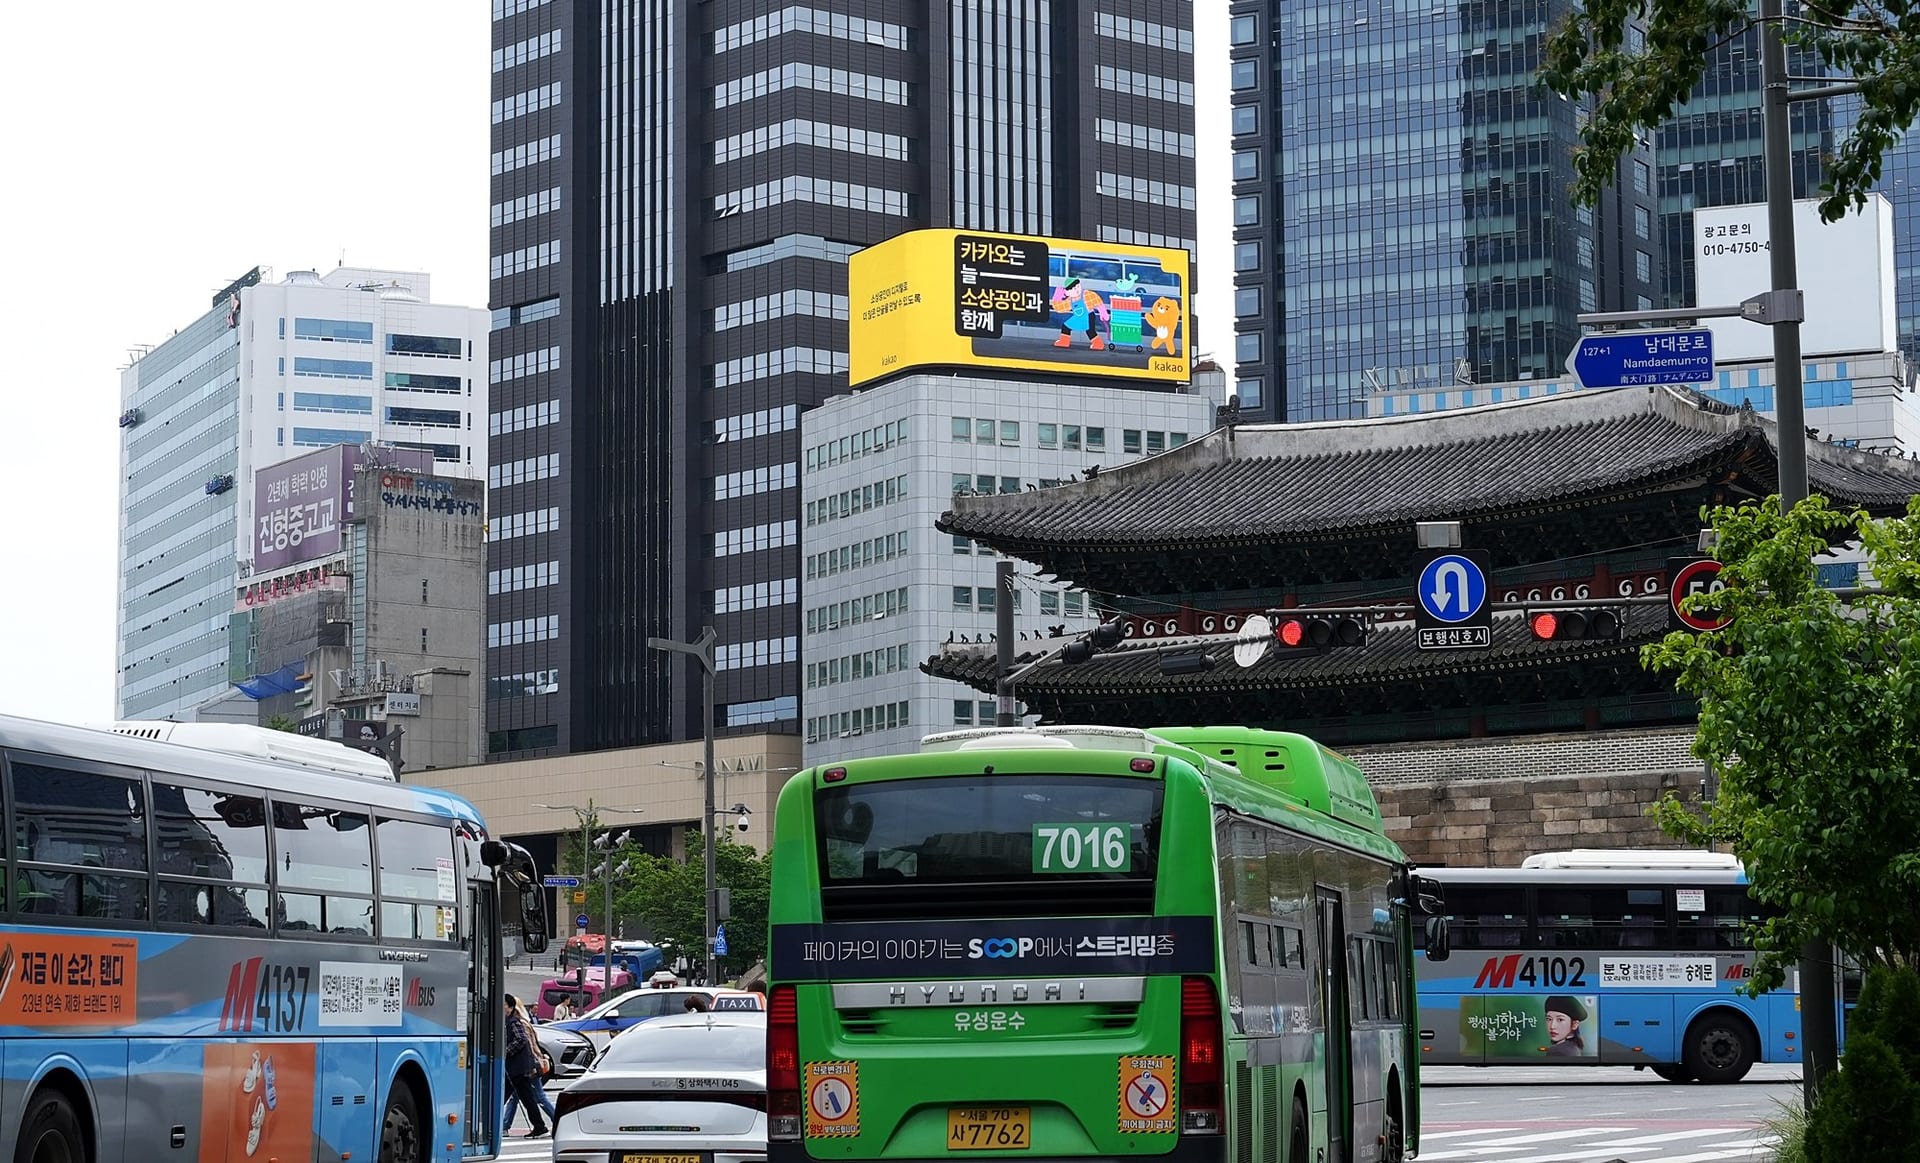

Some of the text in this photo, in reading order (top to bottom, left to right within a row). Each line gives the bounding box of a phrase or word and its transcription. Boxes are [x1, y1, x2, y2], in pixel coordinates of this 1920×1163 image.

[1704, 223, 1751, 239] 광고문의
[960, 241, 1026, 266] 카카오는
[960, 263, 978, 285] 늘
[960, 287, 1043, 313] 소상공인과
[960, 308, 994, 332] 함께
[1645, 335, 1708, 354] 남대문로
[1154, 361, 1183, 373] kakao
[1623, 356, 1709, 369] Namdaemun-ro
[267, 477, 290, 503] 2년제
[292, 470, 308, 497] 학력
[310, 464, 328, 491] 인정
[381, 492, 431, 512] 악세사리
[259, 497, 336, 554] 진형중고교
[1422, 629, 1487, 645] 보행신호시
[1038, 826, 1125, 869] 7016
[803, 940, 880, 962] 페이커의
[885, 939, 964, 961] 이야기는
[1075, 934, 1176, 958] 스트리밍중
[20, 952, 124, 988] 지금 이 순간, 탠디
[1473, 953, 1586, 988] M4102
[1685, 964, 1713, 982] 숭례문
[22, 993, 43, 1013] 23년
[45, 993, 62, 1013] 연속
[64, 994, 81, 1014] 제화
[83, 994, 108, 1013] 브랜드
[218, 955, 311, 1033] M4137
[721, 999, 753, 1008] TAXI
[889, 982, 1086, 1005] HYUNDAI
[954, 1011, 1025, 1031] 유성운수
[1131, 1060, 1163, 1069] 우회전시
[721, 1079, 739, 1088] 045
[991, 1109, 1010, 1121] 70
[968, 1123, 1024, 1145] 7762
